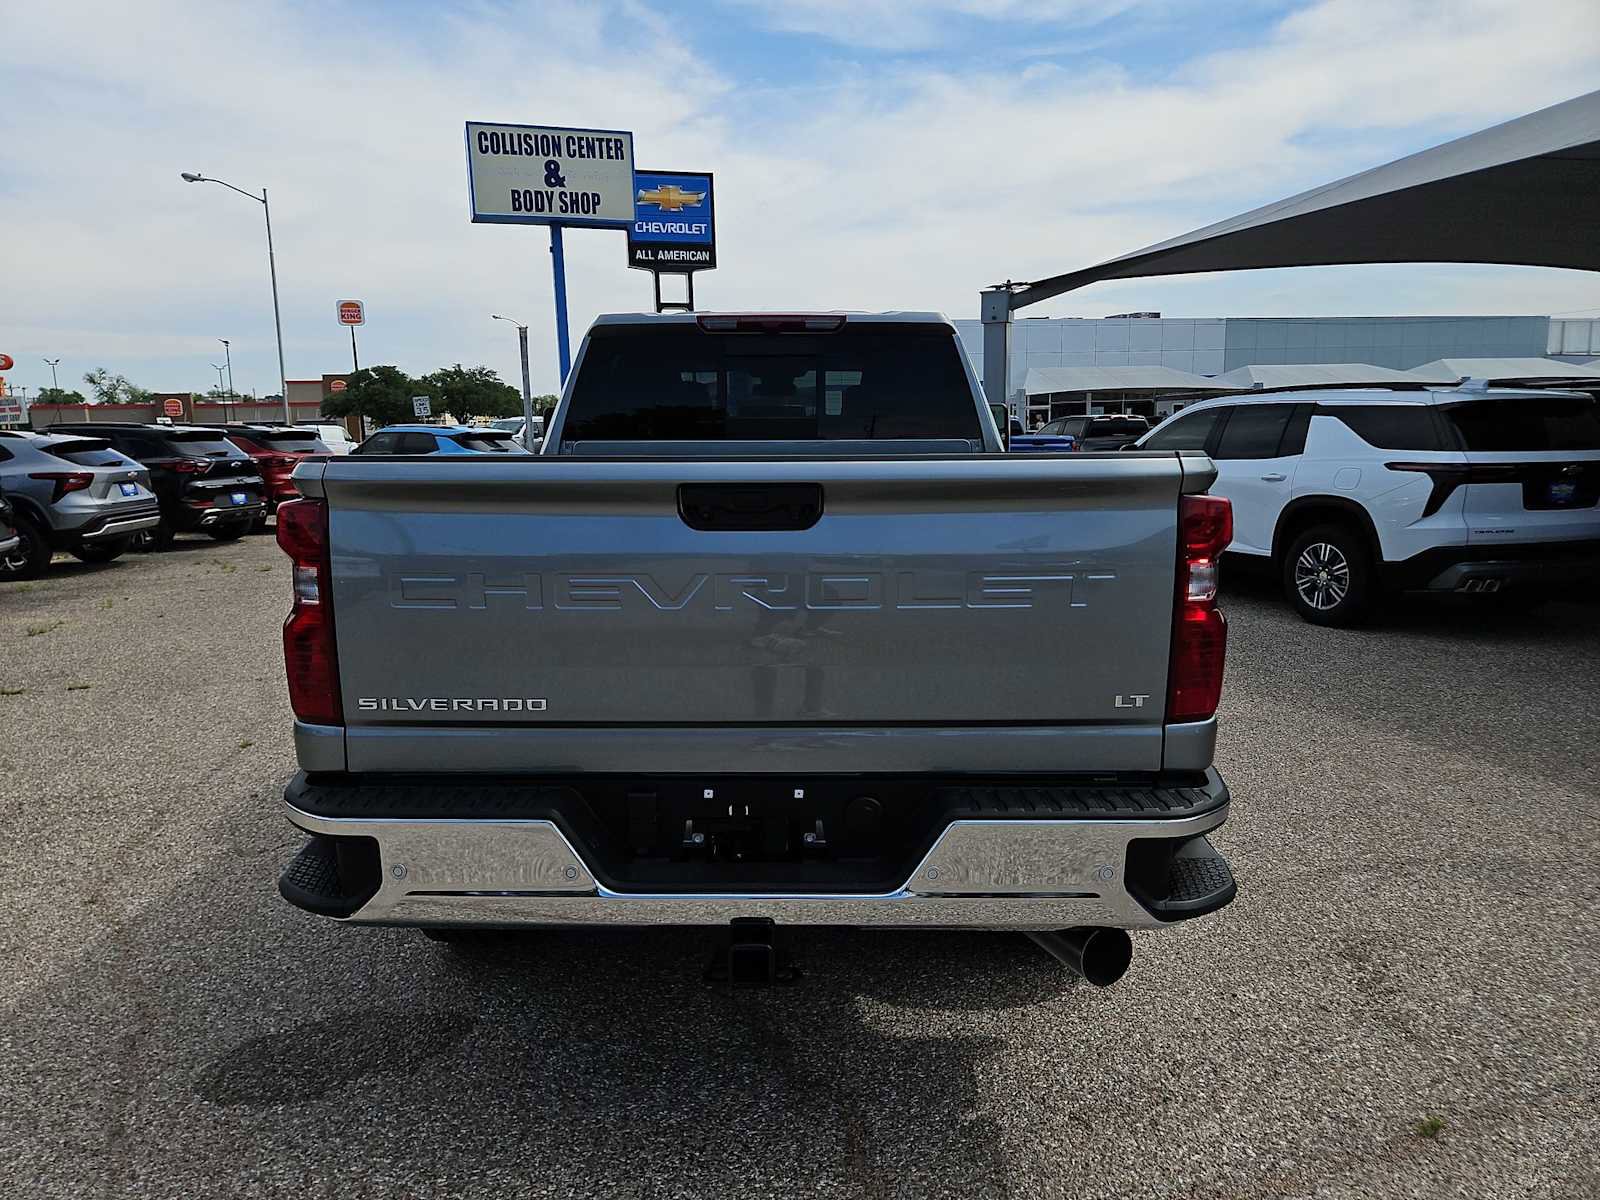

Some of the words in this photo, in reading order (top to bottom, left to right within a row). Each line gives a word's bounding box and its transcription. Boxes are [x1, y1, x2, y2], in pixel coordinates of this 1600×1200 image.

[477, 131, 562, 157] COLLISION
[566, 135, 625, 161] CENTER
[543, 159, 566, 188] &
[510, 189, 555, 213] BODY
[559, 191, 601, 215] SHOP
[634, 221, 708, 235] CHEVROLET
[635, 250, 655, 260] ALL
[657, 250, 710, 261] AMERICAN
[416, 406, 429, 415] 35
[390, 571, 1116, 611] CHEVROLET
[357, 697, 548, 712] SILVERADO
[1114, 694, 1150, 708] LT
